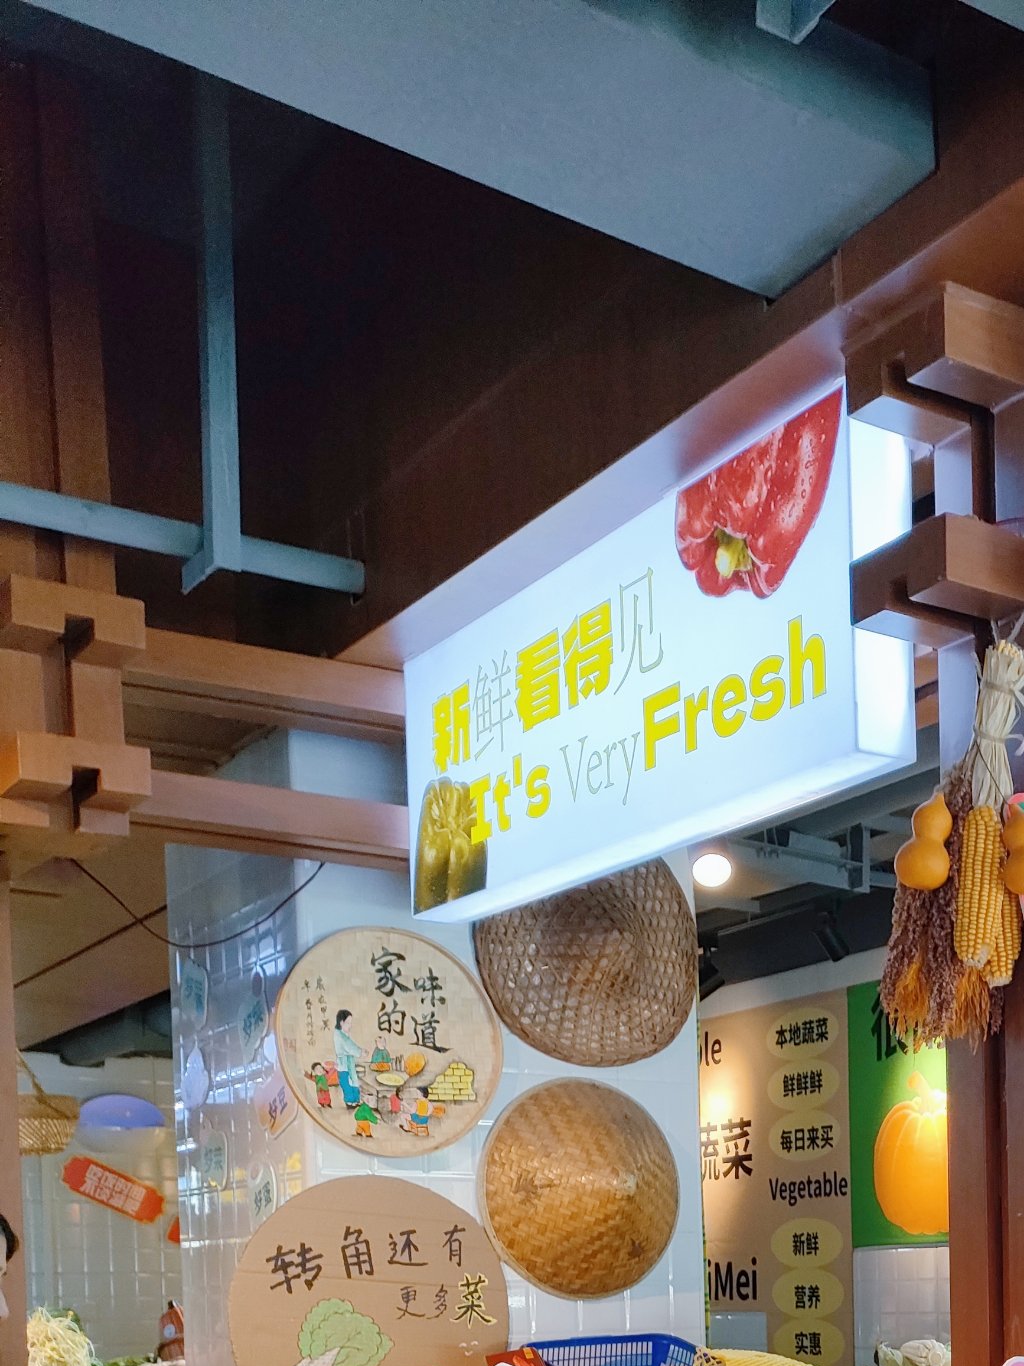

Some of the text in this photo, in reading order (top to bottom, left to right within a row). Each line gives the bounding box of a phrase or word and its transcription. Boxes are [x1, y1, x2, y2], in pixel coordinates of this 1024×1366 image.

[431, 567, 664, 772] 新鲜看得见
[469, 614, 827, 844] It's Very Fresh
[775, 1017, 829, 1049] 本地蔬菜
[782, 1069, 824, 1098] 鲜鲜鲜
[779, 1123, 834, 1153] 每日来买
[769, 1170, 848, 1207] Vegetable
[266, 1224, 467, 1294] 转角还有
[792, 1231, 819, 1257] 新鲜
[396, 1273, 494, 1327] 更多菜
[794, 1284, 821, 1309] 营养
[794, 1331, 822, 1357] 实惠
